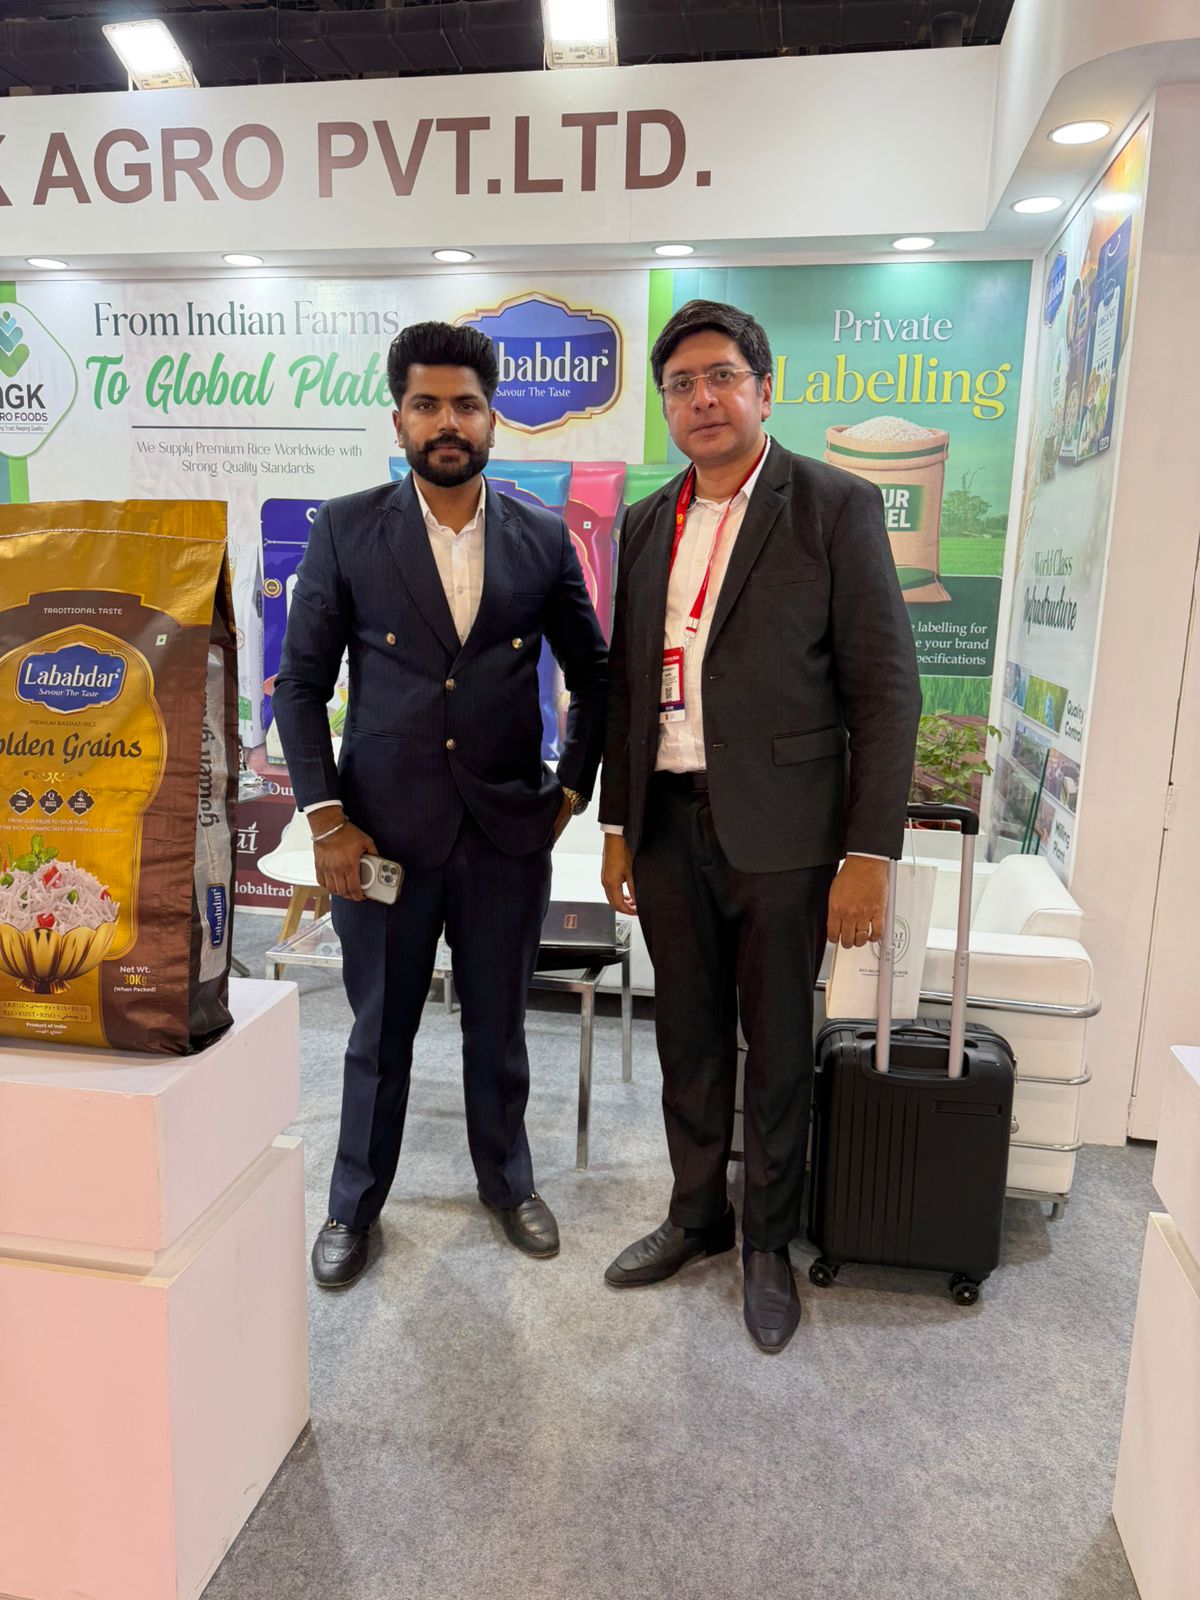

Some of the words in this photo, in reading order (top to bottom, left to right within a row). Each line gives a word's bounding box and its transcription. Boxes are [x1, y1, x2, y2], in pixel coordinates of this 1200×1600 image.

[32, 123, 285, 206] AGRO
[317, 109, 711, 198] PVT.LTD.
[93, 302, 179, 336] From
[187, 301, 286, 335] Indian
[294, 300, 399, 335] Farms
[832, 309, 953, 342] Private
[85, 353, 131, 410] To
[145, 352, 276, 414] Global
[773, 353, 1012, 420] Labelling
[496, 386, 526, 397] Savour
[528, 386, 546, 397] The
[547, 386, 571, 397] Taste
[14, 412, 48, 422] FOODS
[136, 441, 156, 454] We
[158, 441, 195, 457] Supply
[195, 442, 245, 455] Premium
[247, 443, 271, 455] Rice
[274, 443, 336, 456] Worldwide
[338, 444, 362, 457] with
[182, 460, 218, 477] Strong
[222, 460, 258, 476] Quality
[260, 461, 315, 474] Standards
[43, 607, 97, 615] TRADITIONAL
[98, 607, 123, 615] TASTE
[918, 622, 967, 636] labelling
[970, 623, 988, 635] for
[925, 640, 952, 652] your
[955, 639, 989, 650] brand
[38, 688, 64, 697] Savour
[66, 689, 80, 697] The
[81, 690, 99, 698] Taste
[1066, 699, 1086, 725] Quality
[63, 732, 143, 765] Grains
[123, 974, 147, 986] 30Kg
